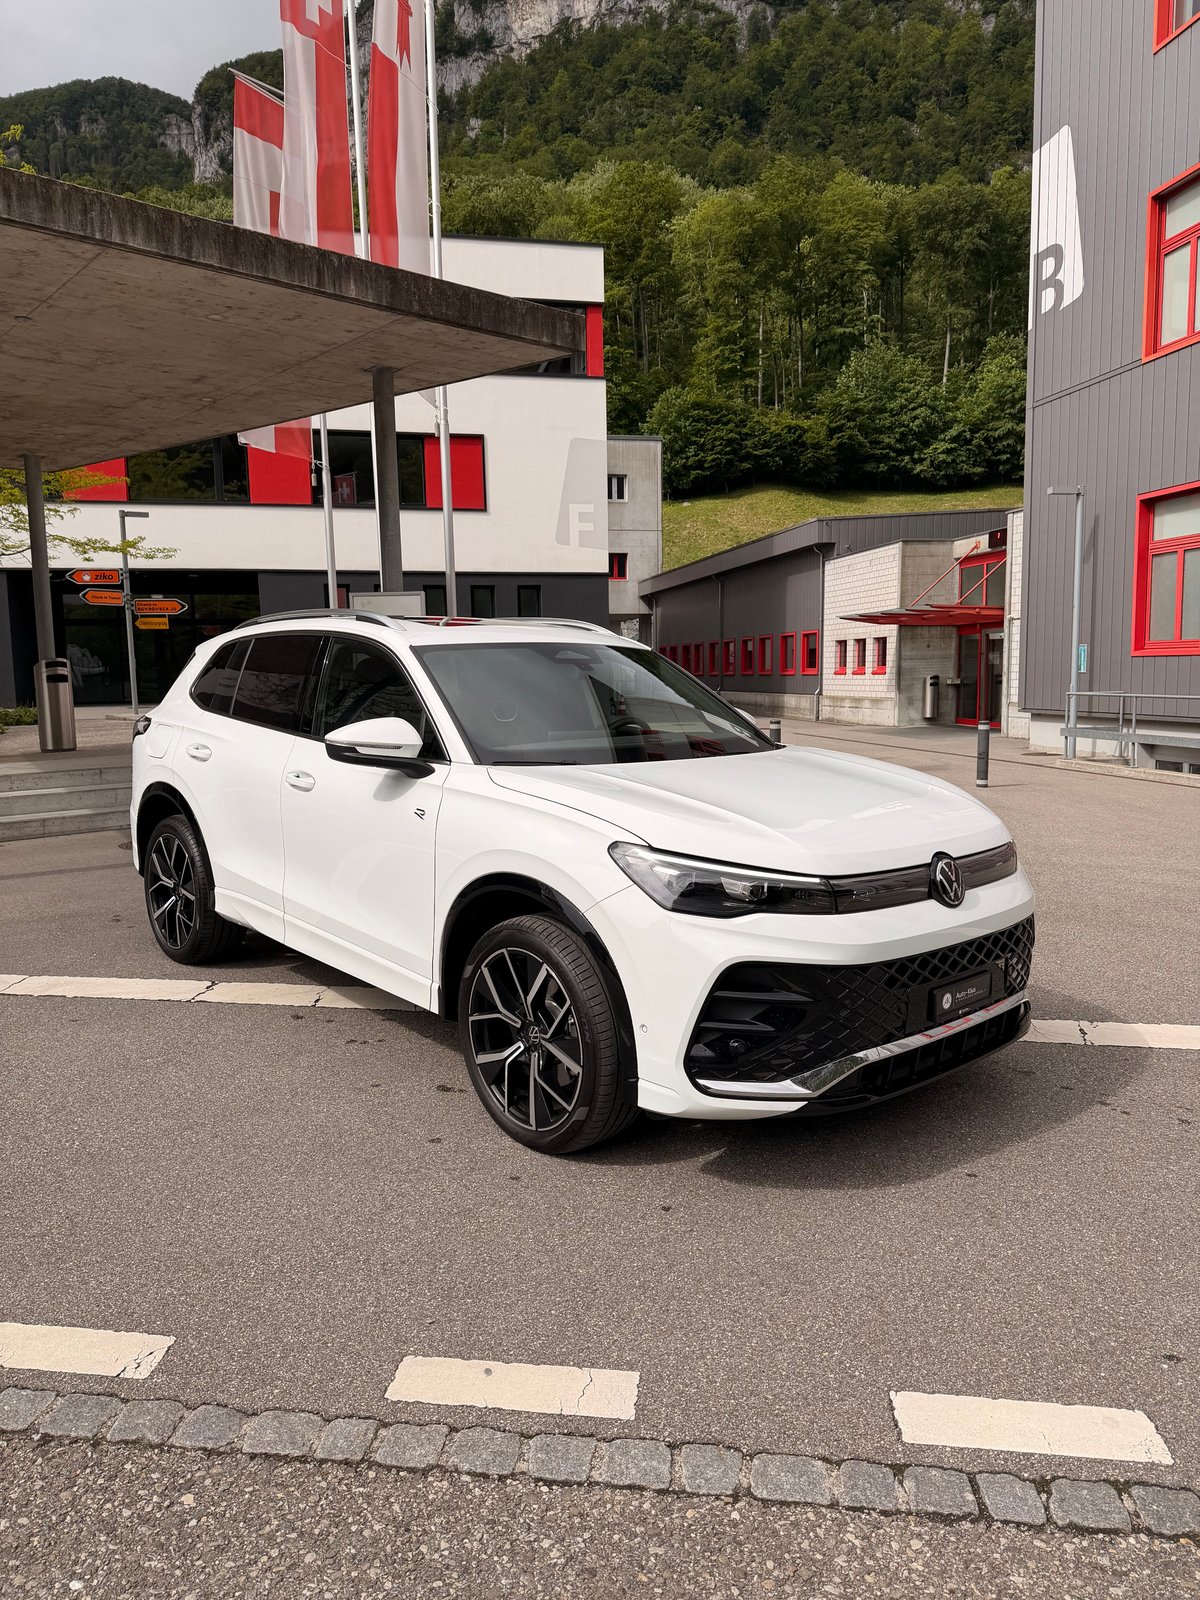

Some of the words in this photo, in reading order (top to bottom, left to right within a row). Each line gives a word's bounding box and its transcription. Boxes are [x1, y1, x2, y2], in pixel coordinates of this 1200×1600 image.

[1032, 243, 1064, 322] B
[568, 503, 594, 547] F
[94, 572, 114, 580] ziko
